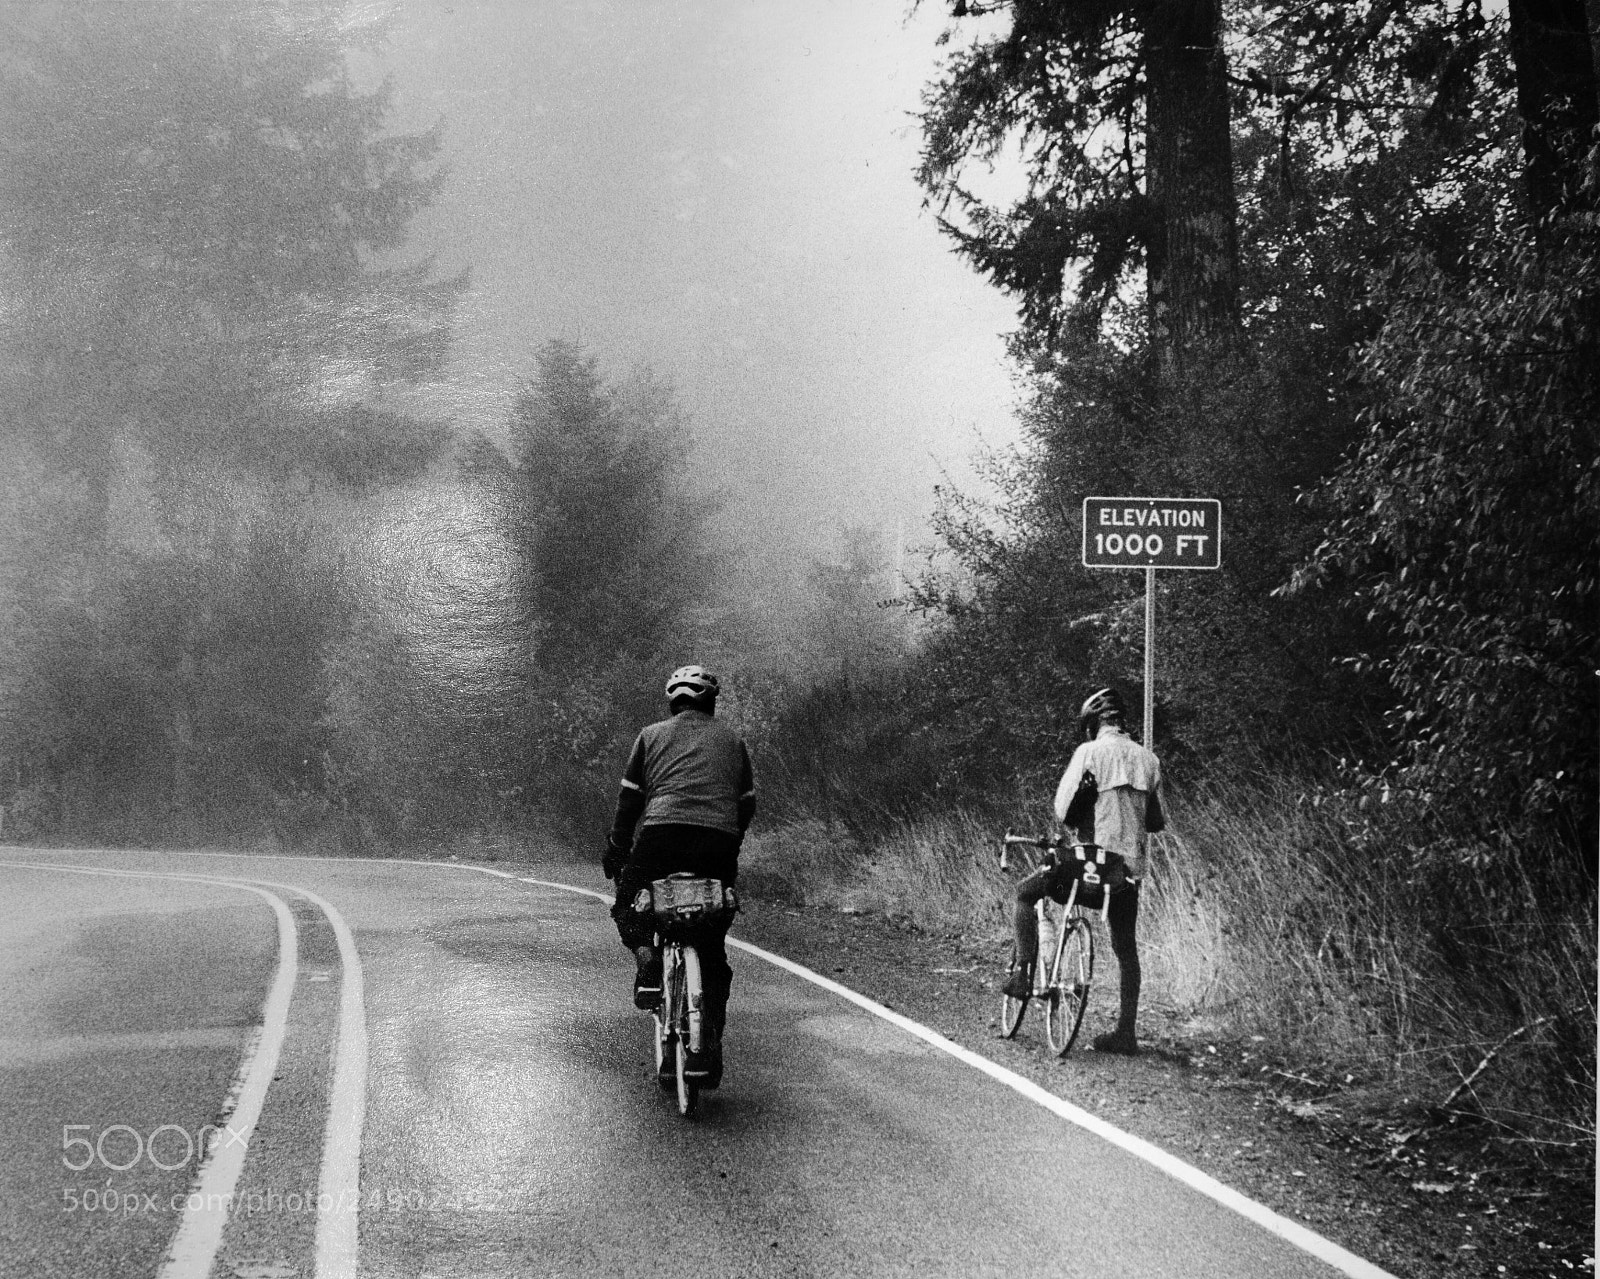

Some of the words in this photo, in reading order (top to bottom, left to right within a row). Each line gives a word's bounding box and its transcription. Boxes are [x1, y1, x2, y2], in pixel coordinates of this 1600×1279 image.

[1100, 508, 1205, 527] ELEVATION
[1095, 533, 1163, 555] 1000
[1176, 535, 1209, 556] FT
